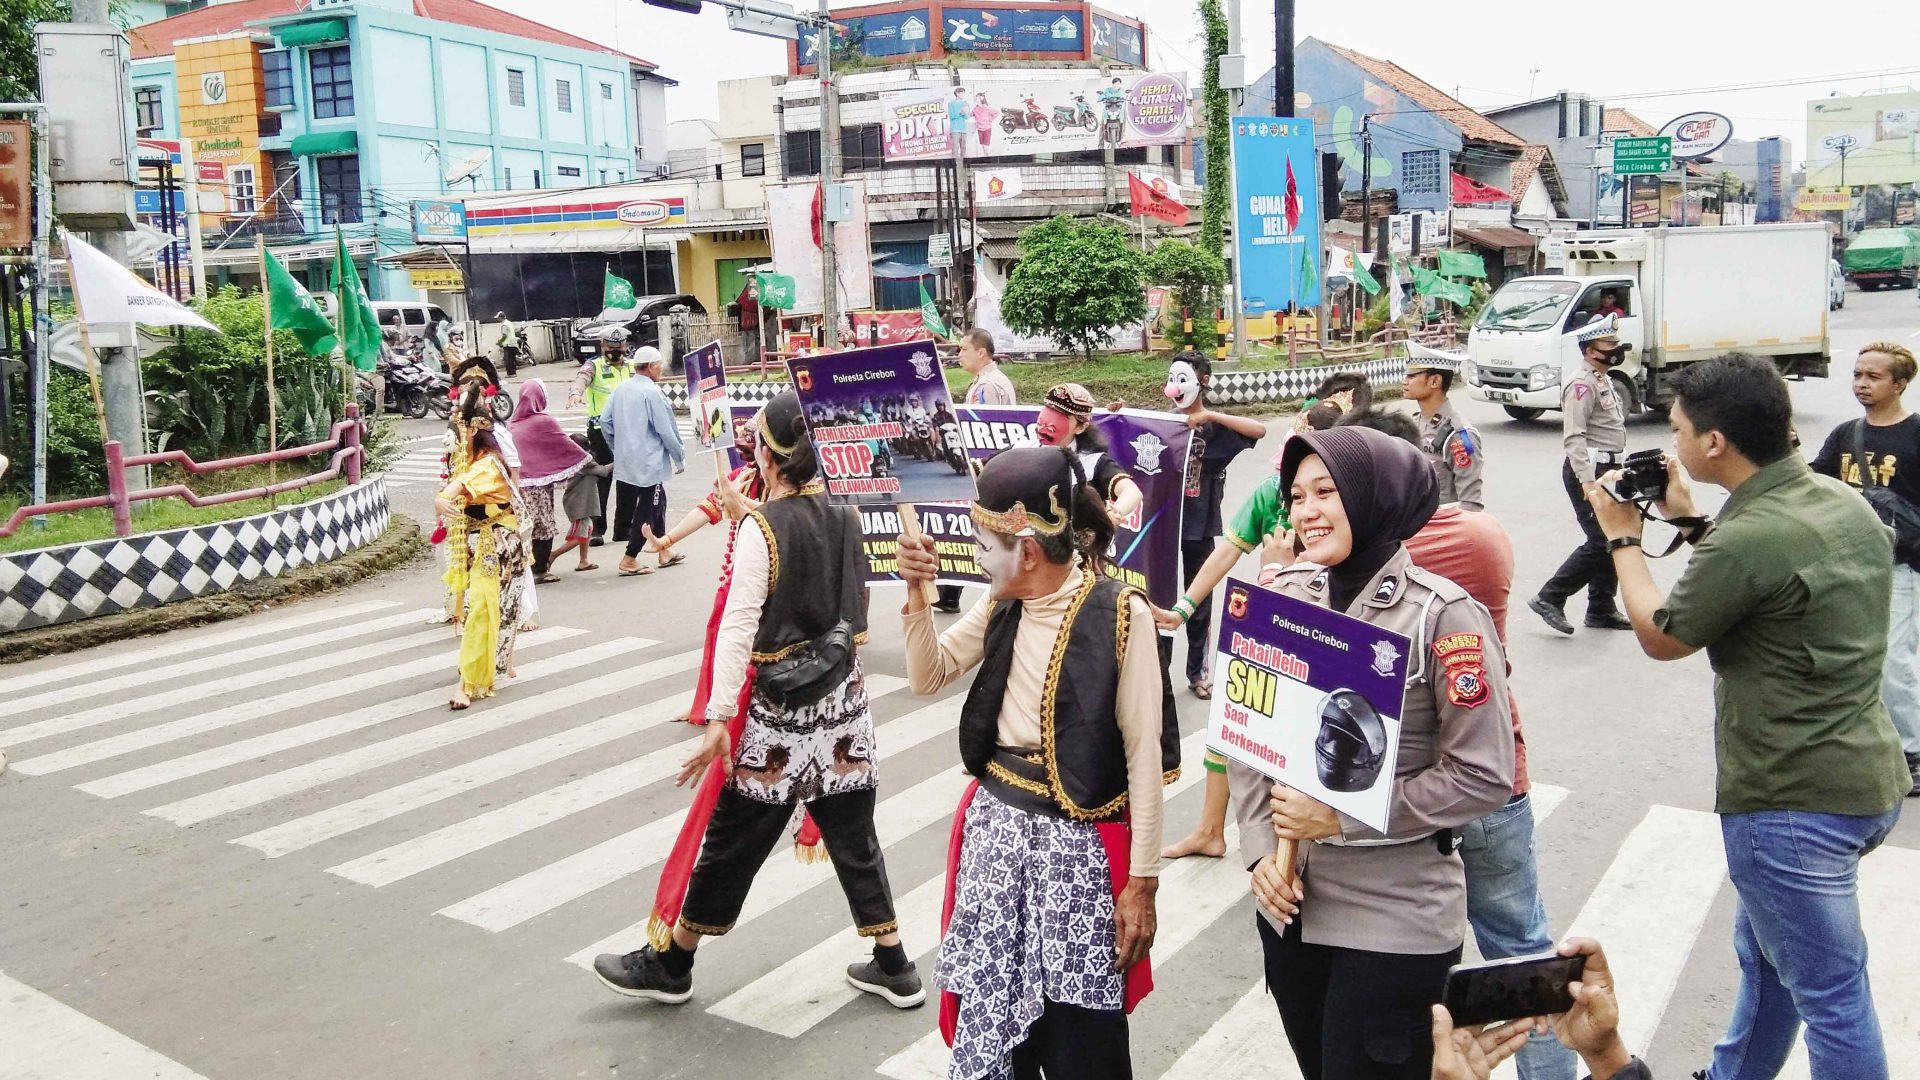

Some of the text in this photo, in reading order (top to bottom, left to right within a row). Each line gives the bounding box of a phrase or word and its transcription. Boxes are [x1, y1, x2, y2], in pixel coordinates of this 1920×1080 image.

[1141, 83, 1174, 94] HEMAT
[897, 102, 945, 118] SPECIAL
[1140, 105, 1174, 116] GRATIS
[1134, 114, 1181, 125] 5X CICILAN
[1686, 118, 1717, 134] PLANET
[885, 114, 948, 143] PDKT
[1694, 131, 1710, 141] BAN
[901, 135, 948, 149] PROMO DISKON
[906, 143, 947, 155] AKHIR TAHUN
[1631, 162, 1655, 170] Cirebon
[622, 207, 661, 218] Indomaret
[833, 369, 896, 384] Polresta Cirebon
[815, 422, 902, 442] DEMI KESELAMATAN
[820, 443, 874, 478] STOP
[829, 477, 900, 495] MELAWAN ARUS
[941, 559, 952, 572] DI
[1126, 569, 1147, 590] RAYA
[1272, 614, 1349, 651] Polresta Cirebon
[1435, 635, 1479, 649] POLRESTA
[1440, 641, 1478, 653] CIREBON
[1231, 632, 1309, 682] Pakai Helm
[1226, 658, 1277, 718] SNI
[1224, 703, 1249, 728] Saat
[1221, 725, 1287, 770] Berkendara
